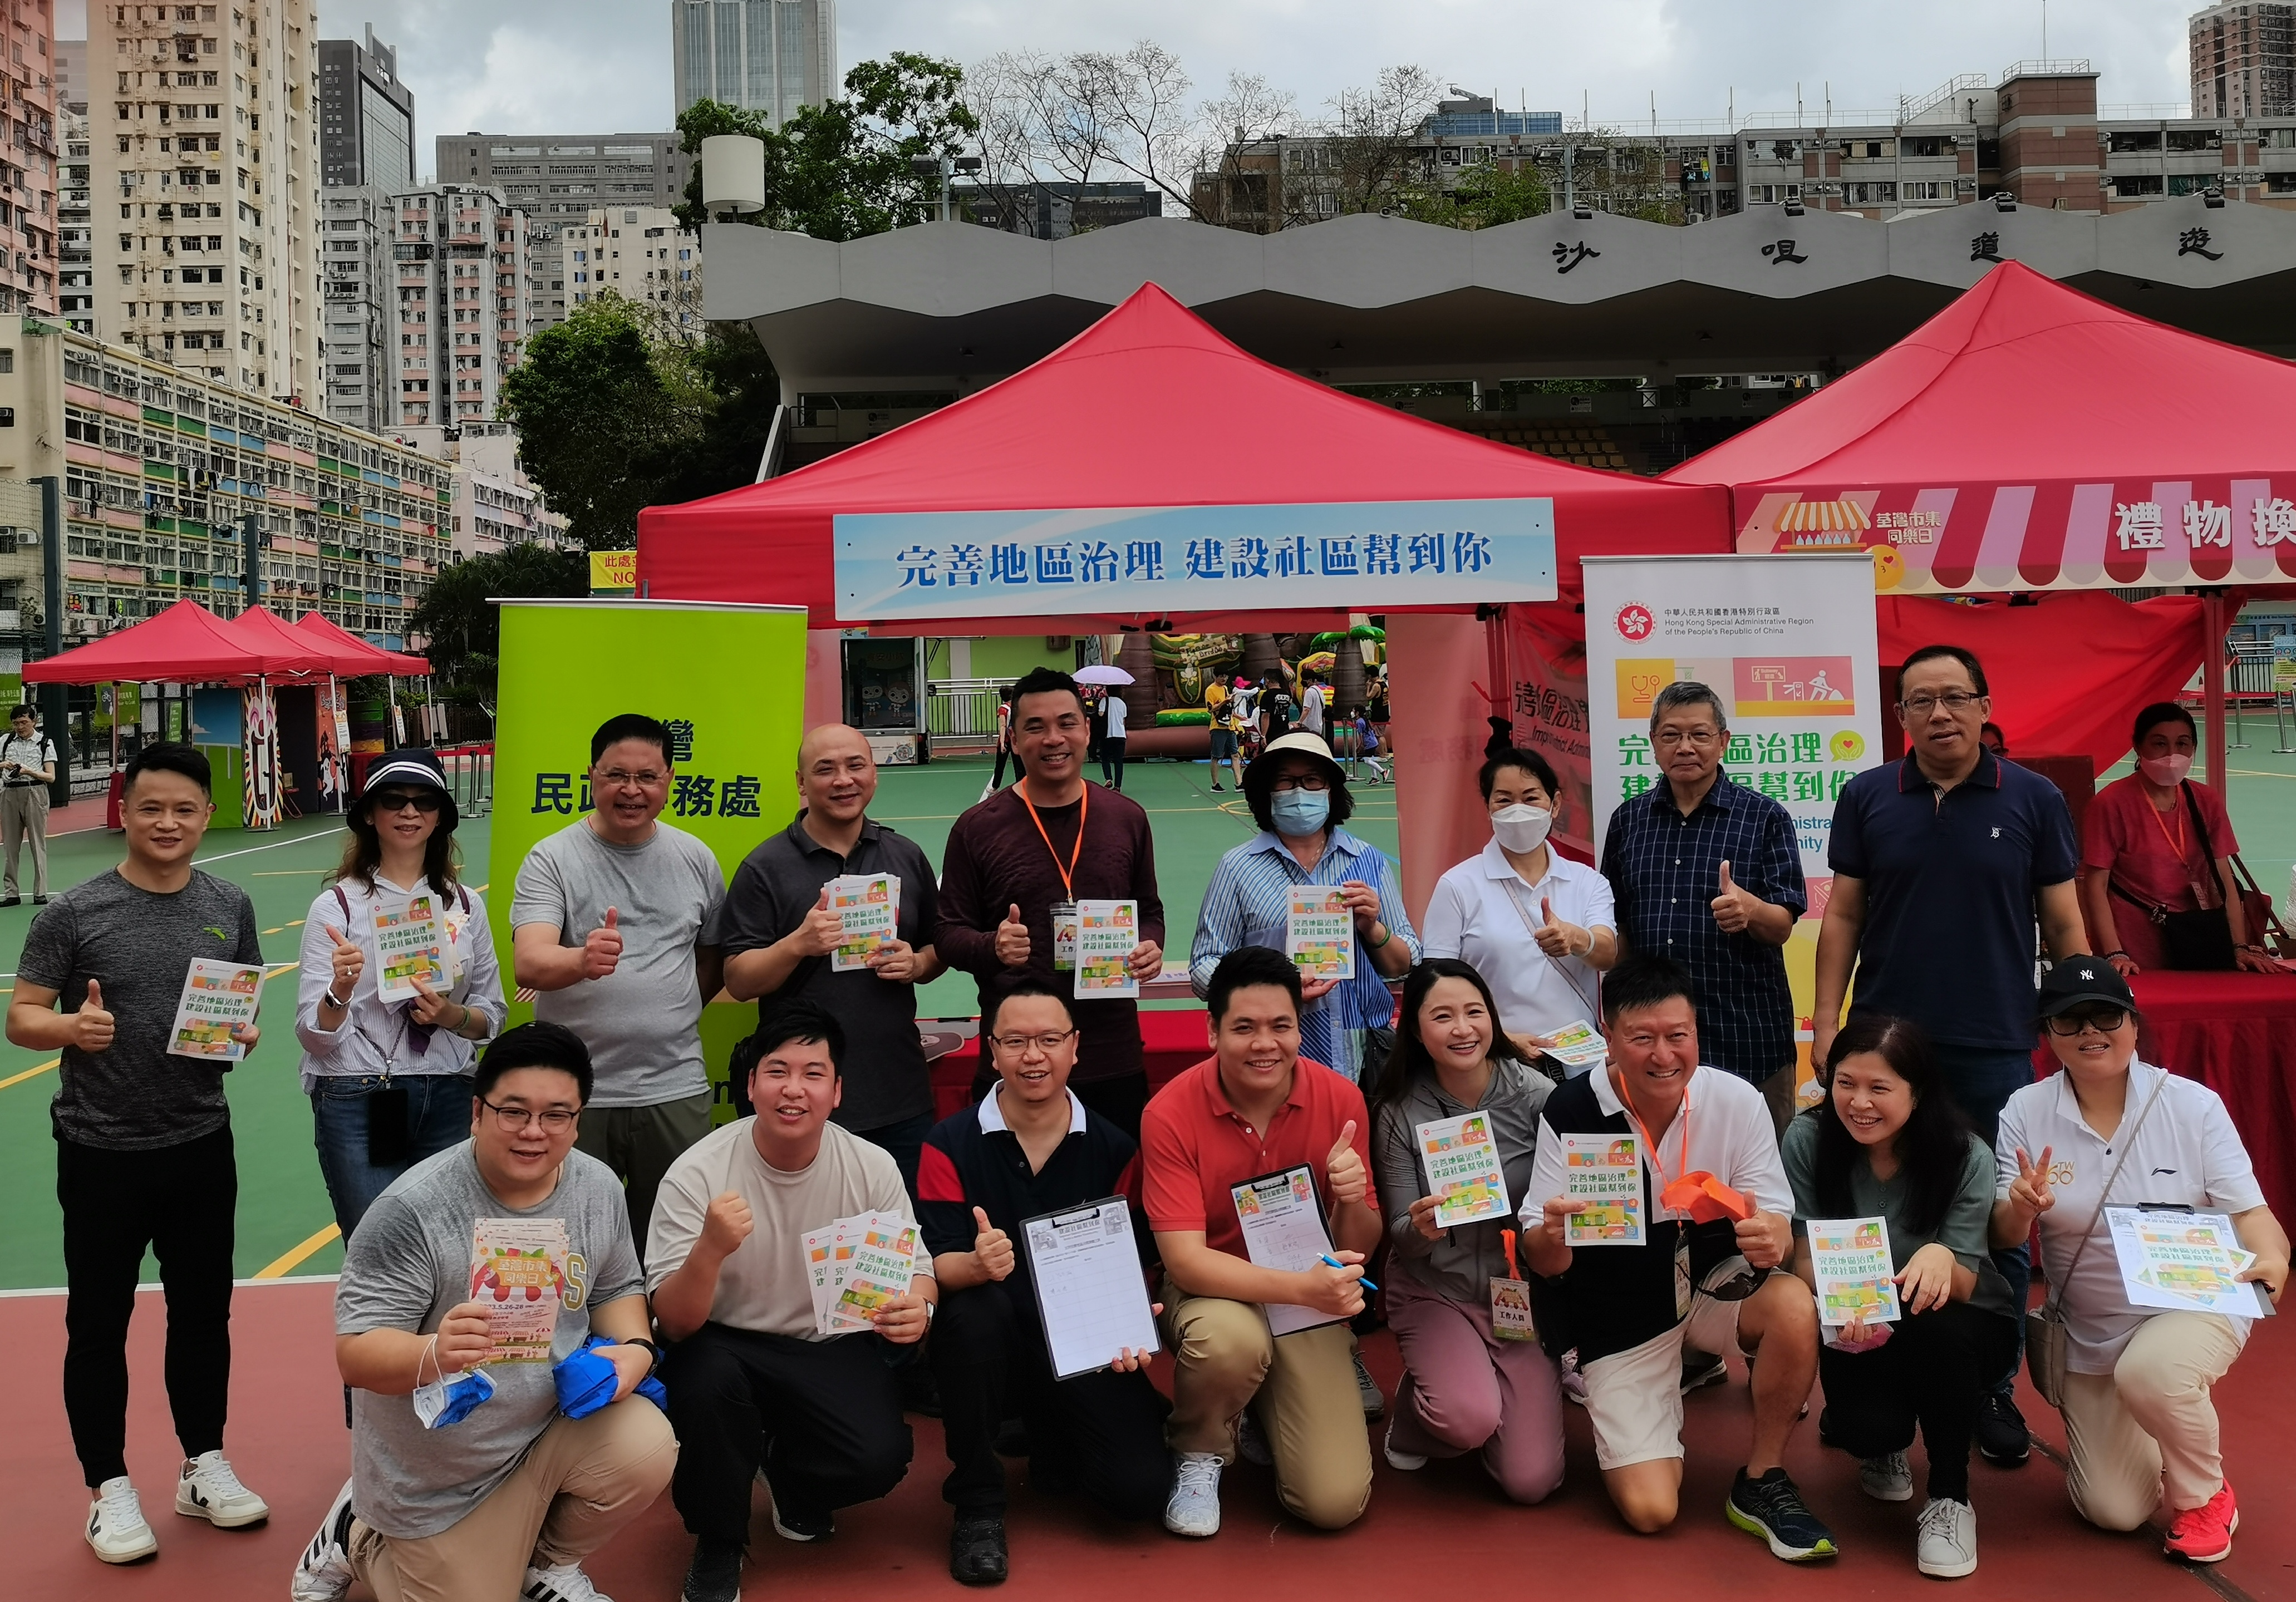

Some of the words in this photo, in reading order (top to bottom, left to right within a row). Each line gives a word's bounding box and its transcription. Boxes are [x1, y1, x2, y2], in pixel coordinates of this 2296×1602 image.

[1876, 511, 1941, 528] 荃灣市集
[2115, 498, 2296, 550] 禮物換
[1887, 529, 1933, 545] 同樂日
[897, 540, 1164, 588] 完善地區治理
[1184, 531, 1492, 580] 建設社區幫到你
[1664, 607, 1780, 617] 中華人民共和國香港特別行政區
[1665, 619, 1684, 627] Hong
[1686, 619, 1705, 627] Kong
[1707, 618, 1733, 627] Special
[1788, 618, 1814, 626] Region
[563, 1252, 587, 1311] S
